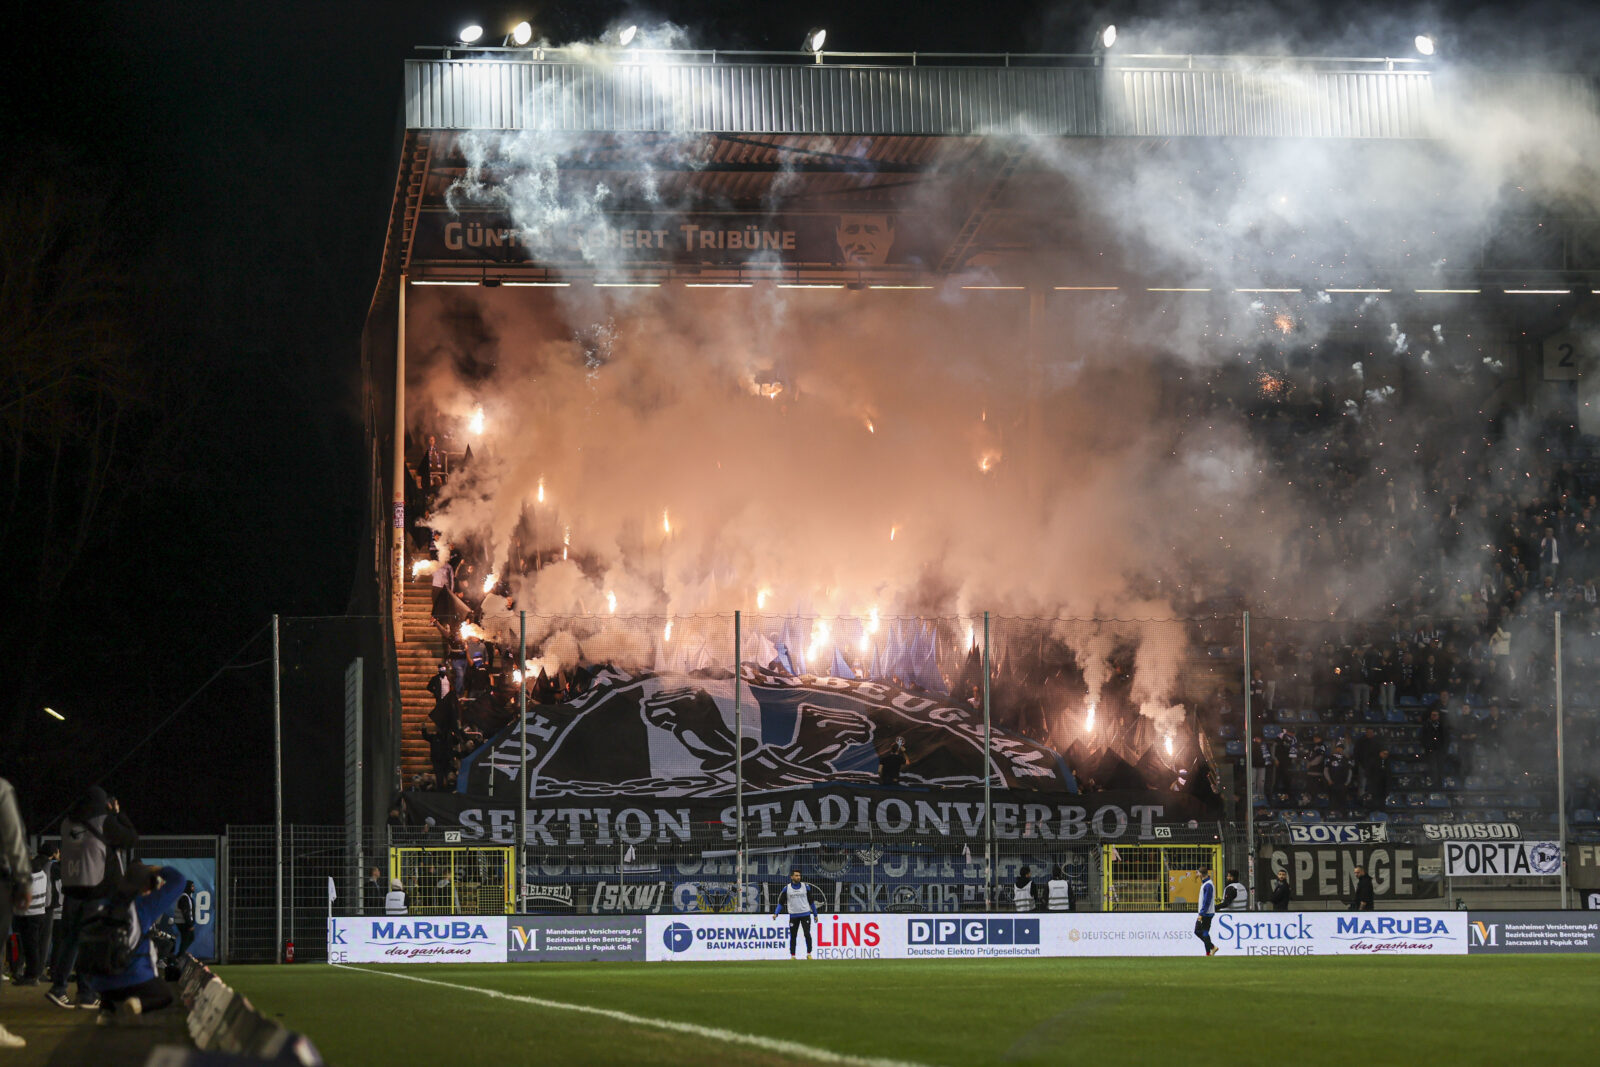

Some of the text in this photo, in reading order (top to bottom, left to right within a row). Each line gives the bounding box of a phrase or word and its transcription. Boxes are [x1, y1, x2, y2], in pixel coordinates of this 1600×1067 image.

[681, 223, 796, 251] TRIBÜNE
[458, 793, 1164, 846] SEKTION STADIONVERBOT
[446, 832, 459, 841] 27
[1156, 828, 1170, 837] 26
[1290, 825, 1359, 842] BOYS
[1423, 823, 1522, 840] SAMSON
[1447, 844, 1530, 873] PORTA
[1271, 850, 1413, 896] SPENGE
[522, 883, 571, 899] IELEFELD
[195, 890, 211, 925] e
[328, 919, 348, 945] k
[589, 928, 631, 936] Versicherung
[911, 922, 985, 942] DPG
[1081, 930, 1193, 940] DEUTSCHE DIGITAL ASSETS
[1218, 914, 1314, 949] Spruck
[602, 936, 640, 944] Bentzinger,
[706, 941, 786, 950] BAUMASCHINEN
[1350, 941, 1433, 952] das gasthaus
[385, 946, 471, 958] das gasthaus
[817, 948, 880, 960] RECYCLING
[907, 947, 1041, 958] Deutsche Elektro Prüfgesellschaft
[1247, 945, 1314, 956] IT-SERVICE
